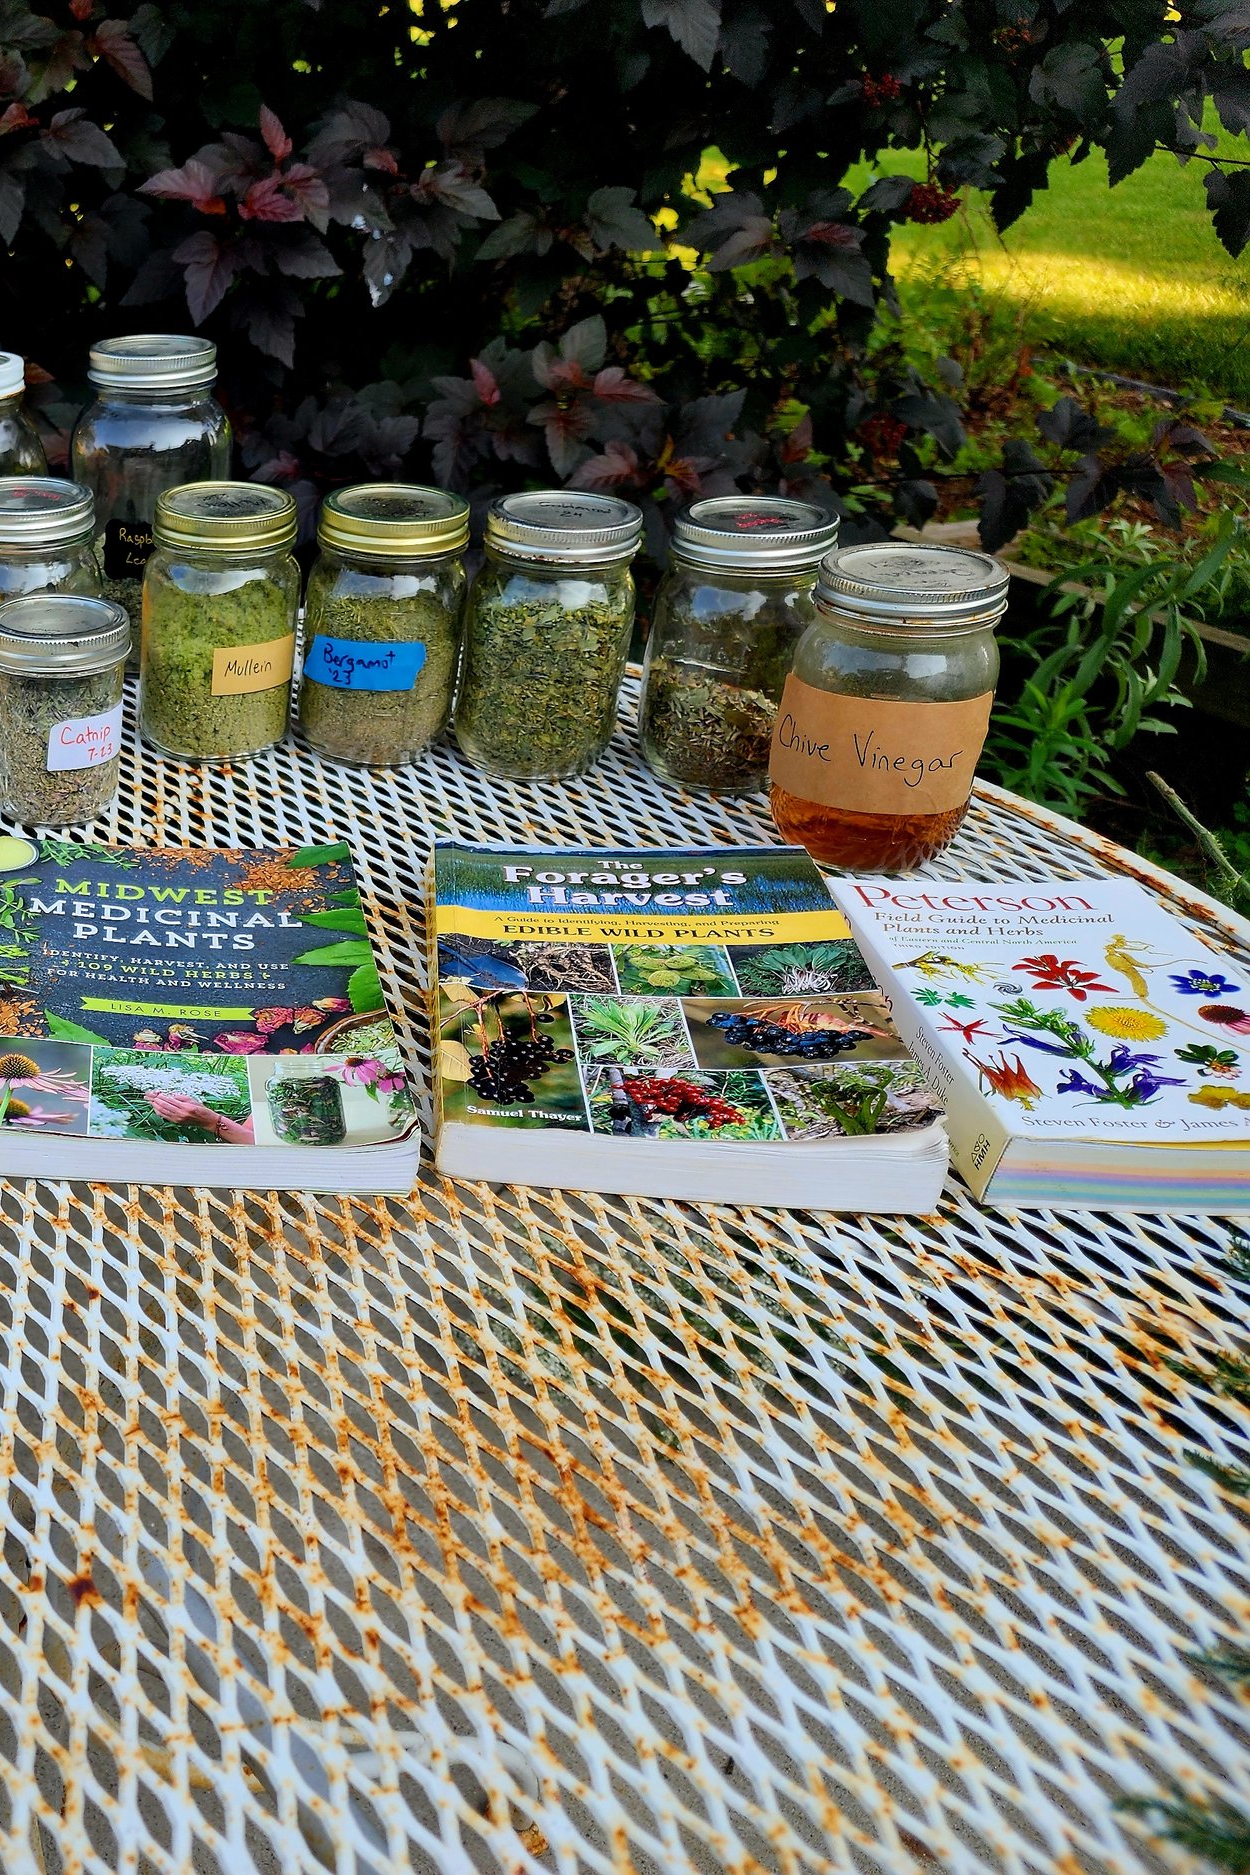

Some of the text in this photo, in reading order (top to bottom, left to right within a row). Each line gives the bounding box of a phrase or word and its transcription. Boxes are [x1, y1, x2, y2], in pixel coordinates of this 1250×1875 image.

[119, 527, 153, 545] Raspb
[126, 552, 147, 565] Lea
[224, 657, 273, 678] Mullein
[323, 642, 397, 672] Bergamot
[60, 725, 111, 745] Catnip
[778, 713, 965, 788] Chive Vinegar
[597, 859, 644, 871] The
[502, 865, 748, 890] Forager's
[54, 878, 274, 907] MIDWEST
[526, 885, 735, 907] Harvest
[847, 883, 1100, 913] Peterson
[28, 897, 304, 929] MEDICINAL
[507, 915, 540, 924] Guide
[558, 917, 622, 927] Identifying,
[625, 918, 691, 928] Harvesting,
[695, 918, 716, 926] and
[720, 919, 780, 928] Preparing
[874, 911, 1116, 925] Field Guide to Medicinal
[72, 922, 256, 951] PLANTS
[503, 924, 776, 939] EDIBLE WILD PLANTS
[882, 922, 1044, 936] Plants and Herbs
[961, 937, 999, 945] Central
[42, 948, 290, 971] IDENTIFY, HARVEST, AND USE
[78, 959, 255, 981] 109 WILD HERBS
[47, 967, 287, 990] FOR HEALTH AND WELLNESS
[110, 1002, 223, 1018] LISA M. ROSE
[915, 1025, 955, 1085] Steven Foster
[931, 1075, 949, 1107] Duke
[465, 1104, 583, 1121] Samuel Thayer
[1021, 1115, 1086, 1128] Steven
[1087, 1116, 1150, 1129] Foster
[1154, 1118, 1176, 1129] &
[1179, 1117, 1239, 1132] James
[973, 1138, 991, 1171] HMH
